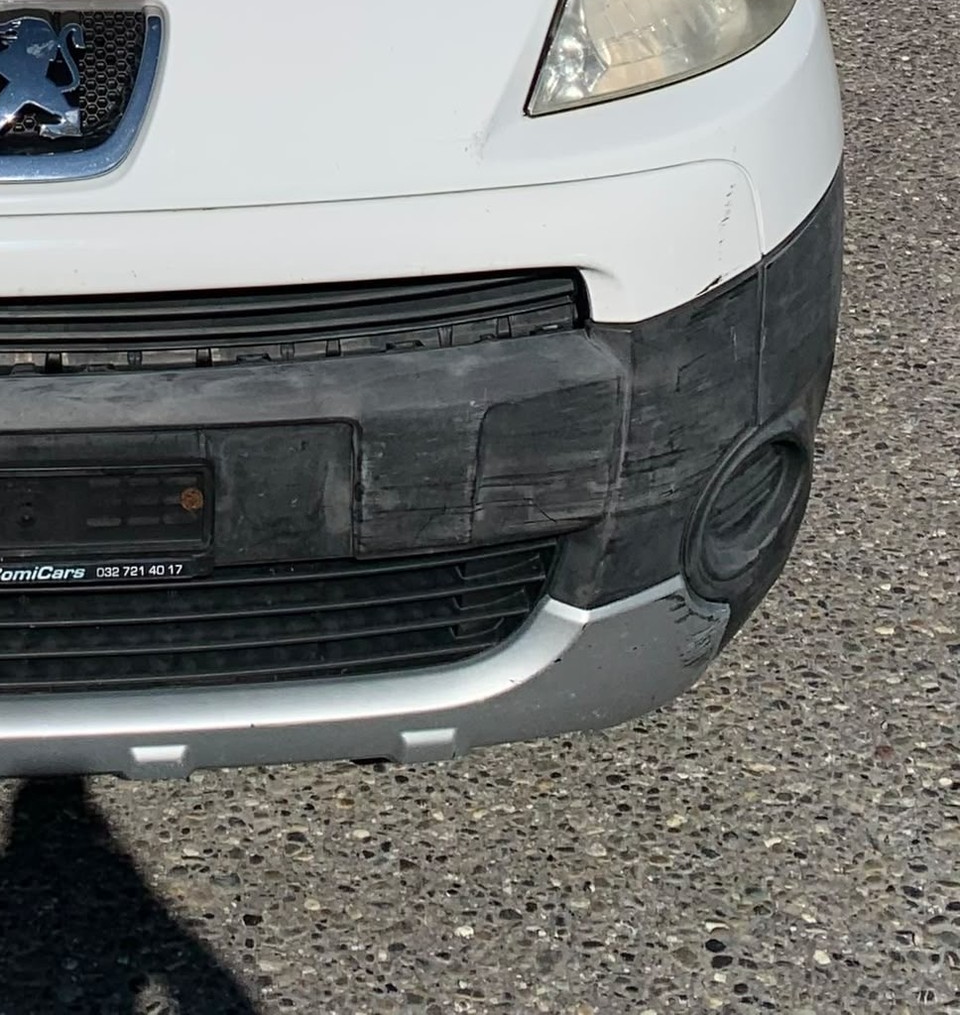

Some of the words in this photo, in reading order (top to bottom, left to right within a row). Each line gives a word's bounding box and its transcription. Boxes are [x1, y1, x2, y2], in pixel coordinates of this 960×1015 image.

[96, 566, 120, 578] 032
[123, 565, 145, 577] 721
[148, 564, 165, 576] 40
[167, 564, 183, 576] 17
